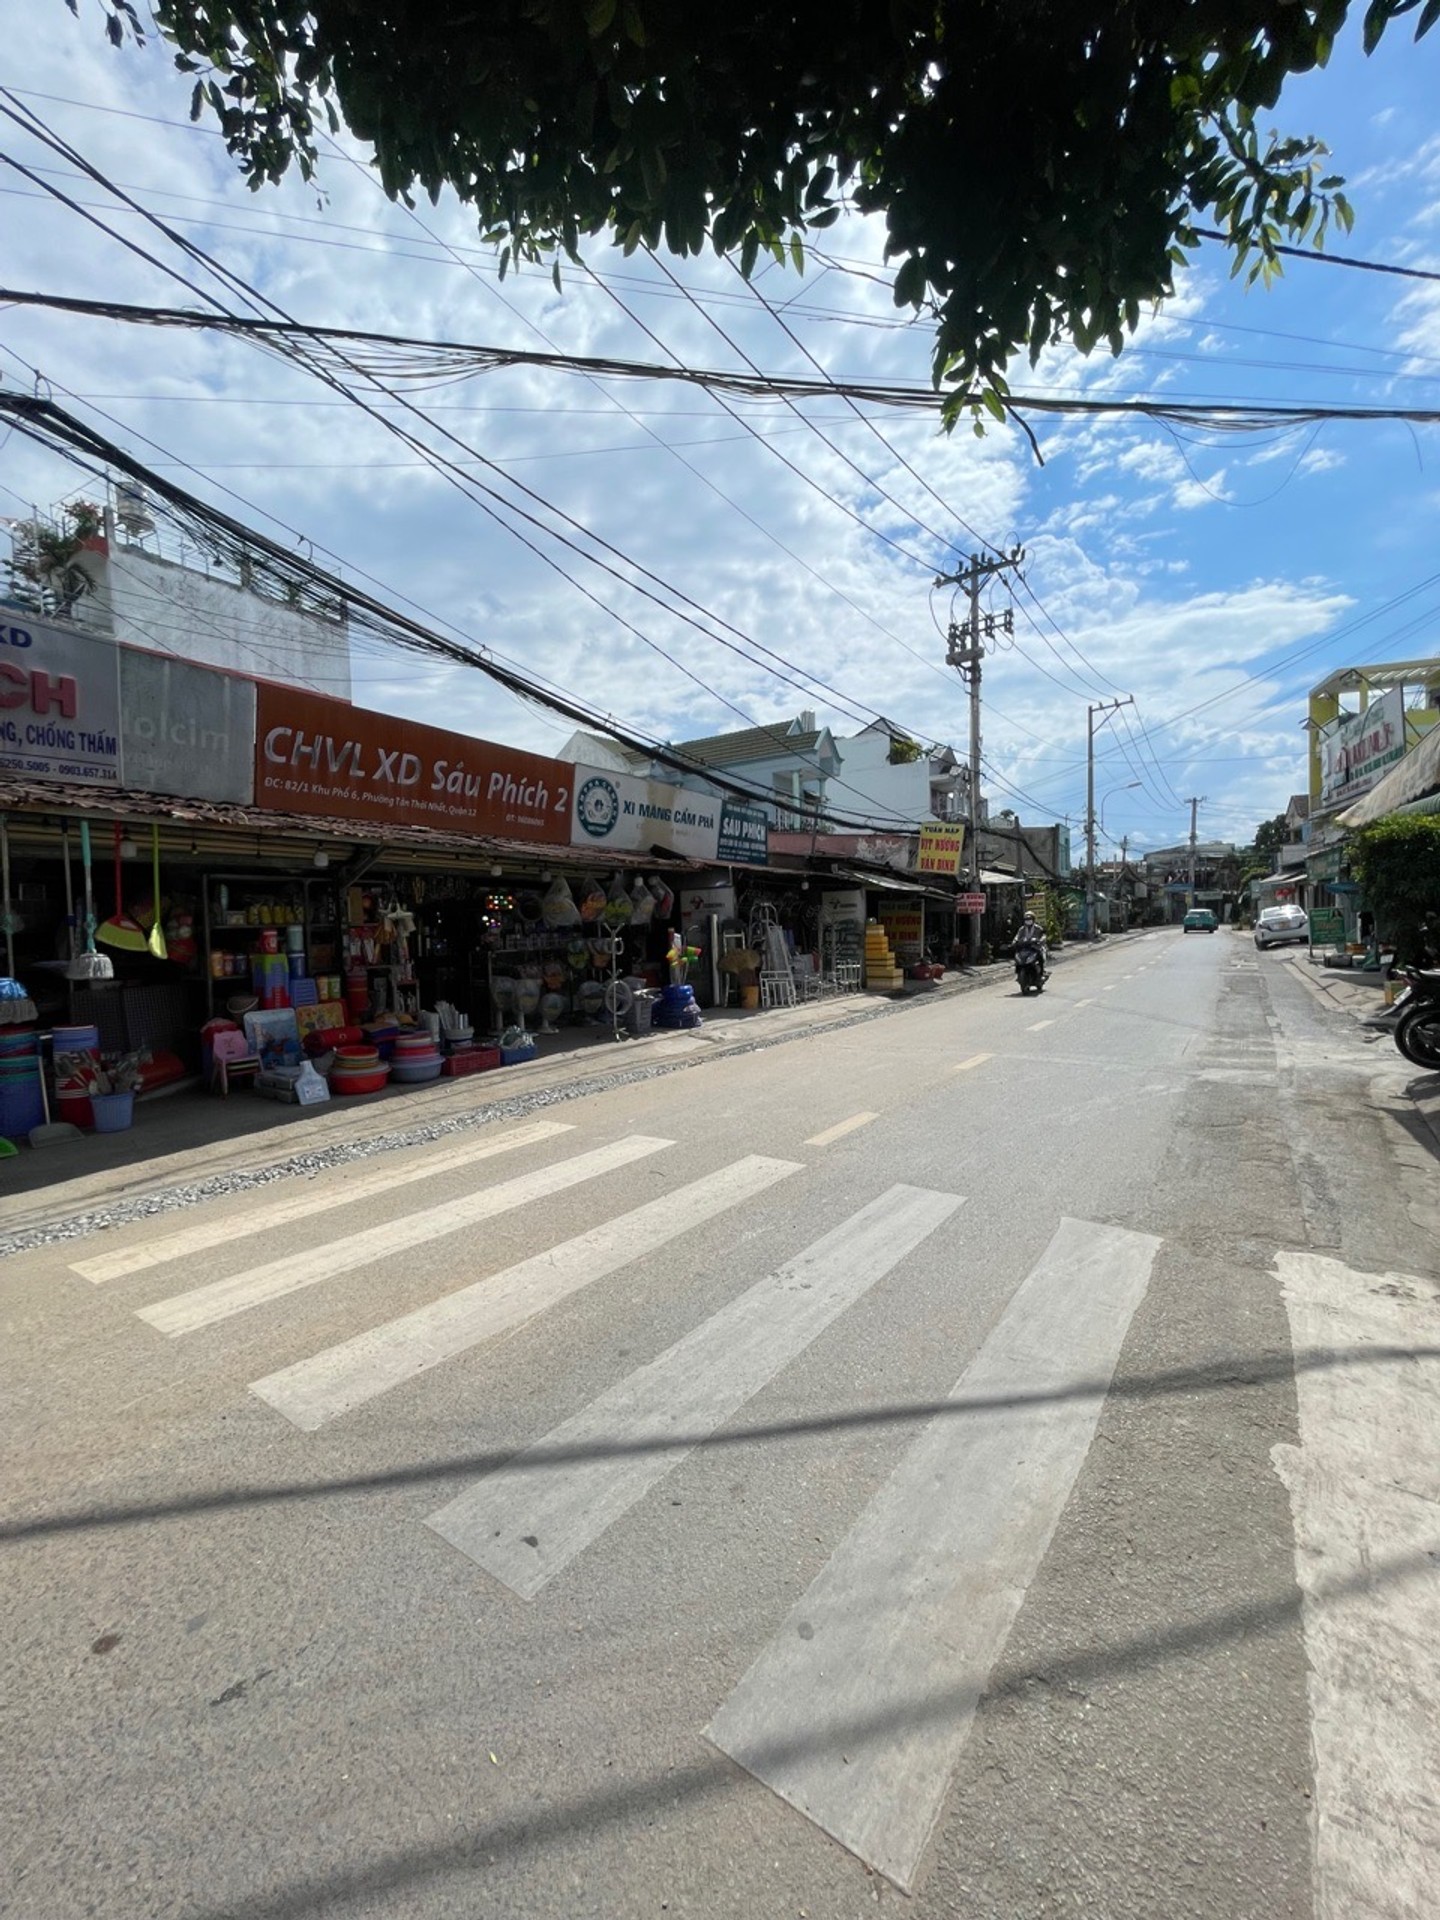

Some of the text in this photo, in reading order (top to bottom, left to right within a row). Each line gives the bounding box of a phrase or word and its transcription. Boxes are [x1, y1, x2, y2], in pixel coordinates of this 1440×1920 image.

[26, 720, 75, 750] CHỐNG
[78, 729, 117, 756] THẤM
[264, 726, 365, 777] CHVL
[372, 748, 422, 785] XD
[431, 761, 482, 797] Sáu
[487, 772, 548, 809] Phích
[554, 787, 569, 812] 2
[264, 777, 283, 789] ĐC:
[285, 781, 309, 793] 82/1
[311, 784, 330, 795] Khu
[332, 786, 350, 798] Phố
[351, 790, 360, 801] 6,
[362, 792, 395, 808] Phường
[395, 796, 410, 807] Tân
[448, 805, 467, 817] Quận
[467, 808, 477, 817] 12
[623, 800, 635, 815] XI
[722, 815, 741, 837] SÁU
